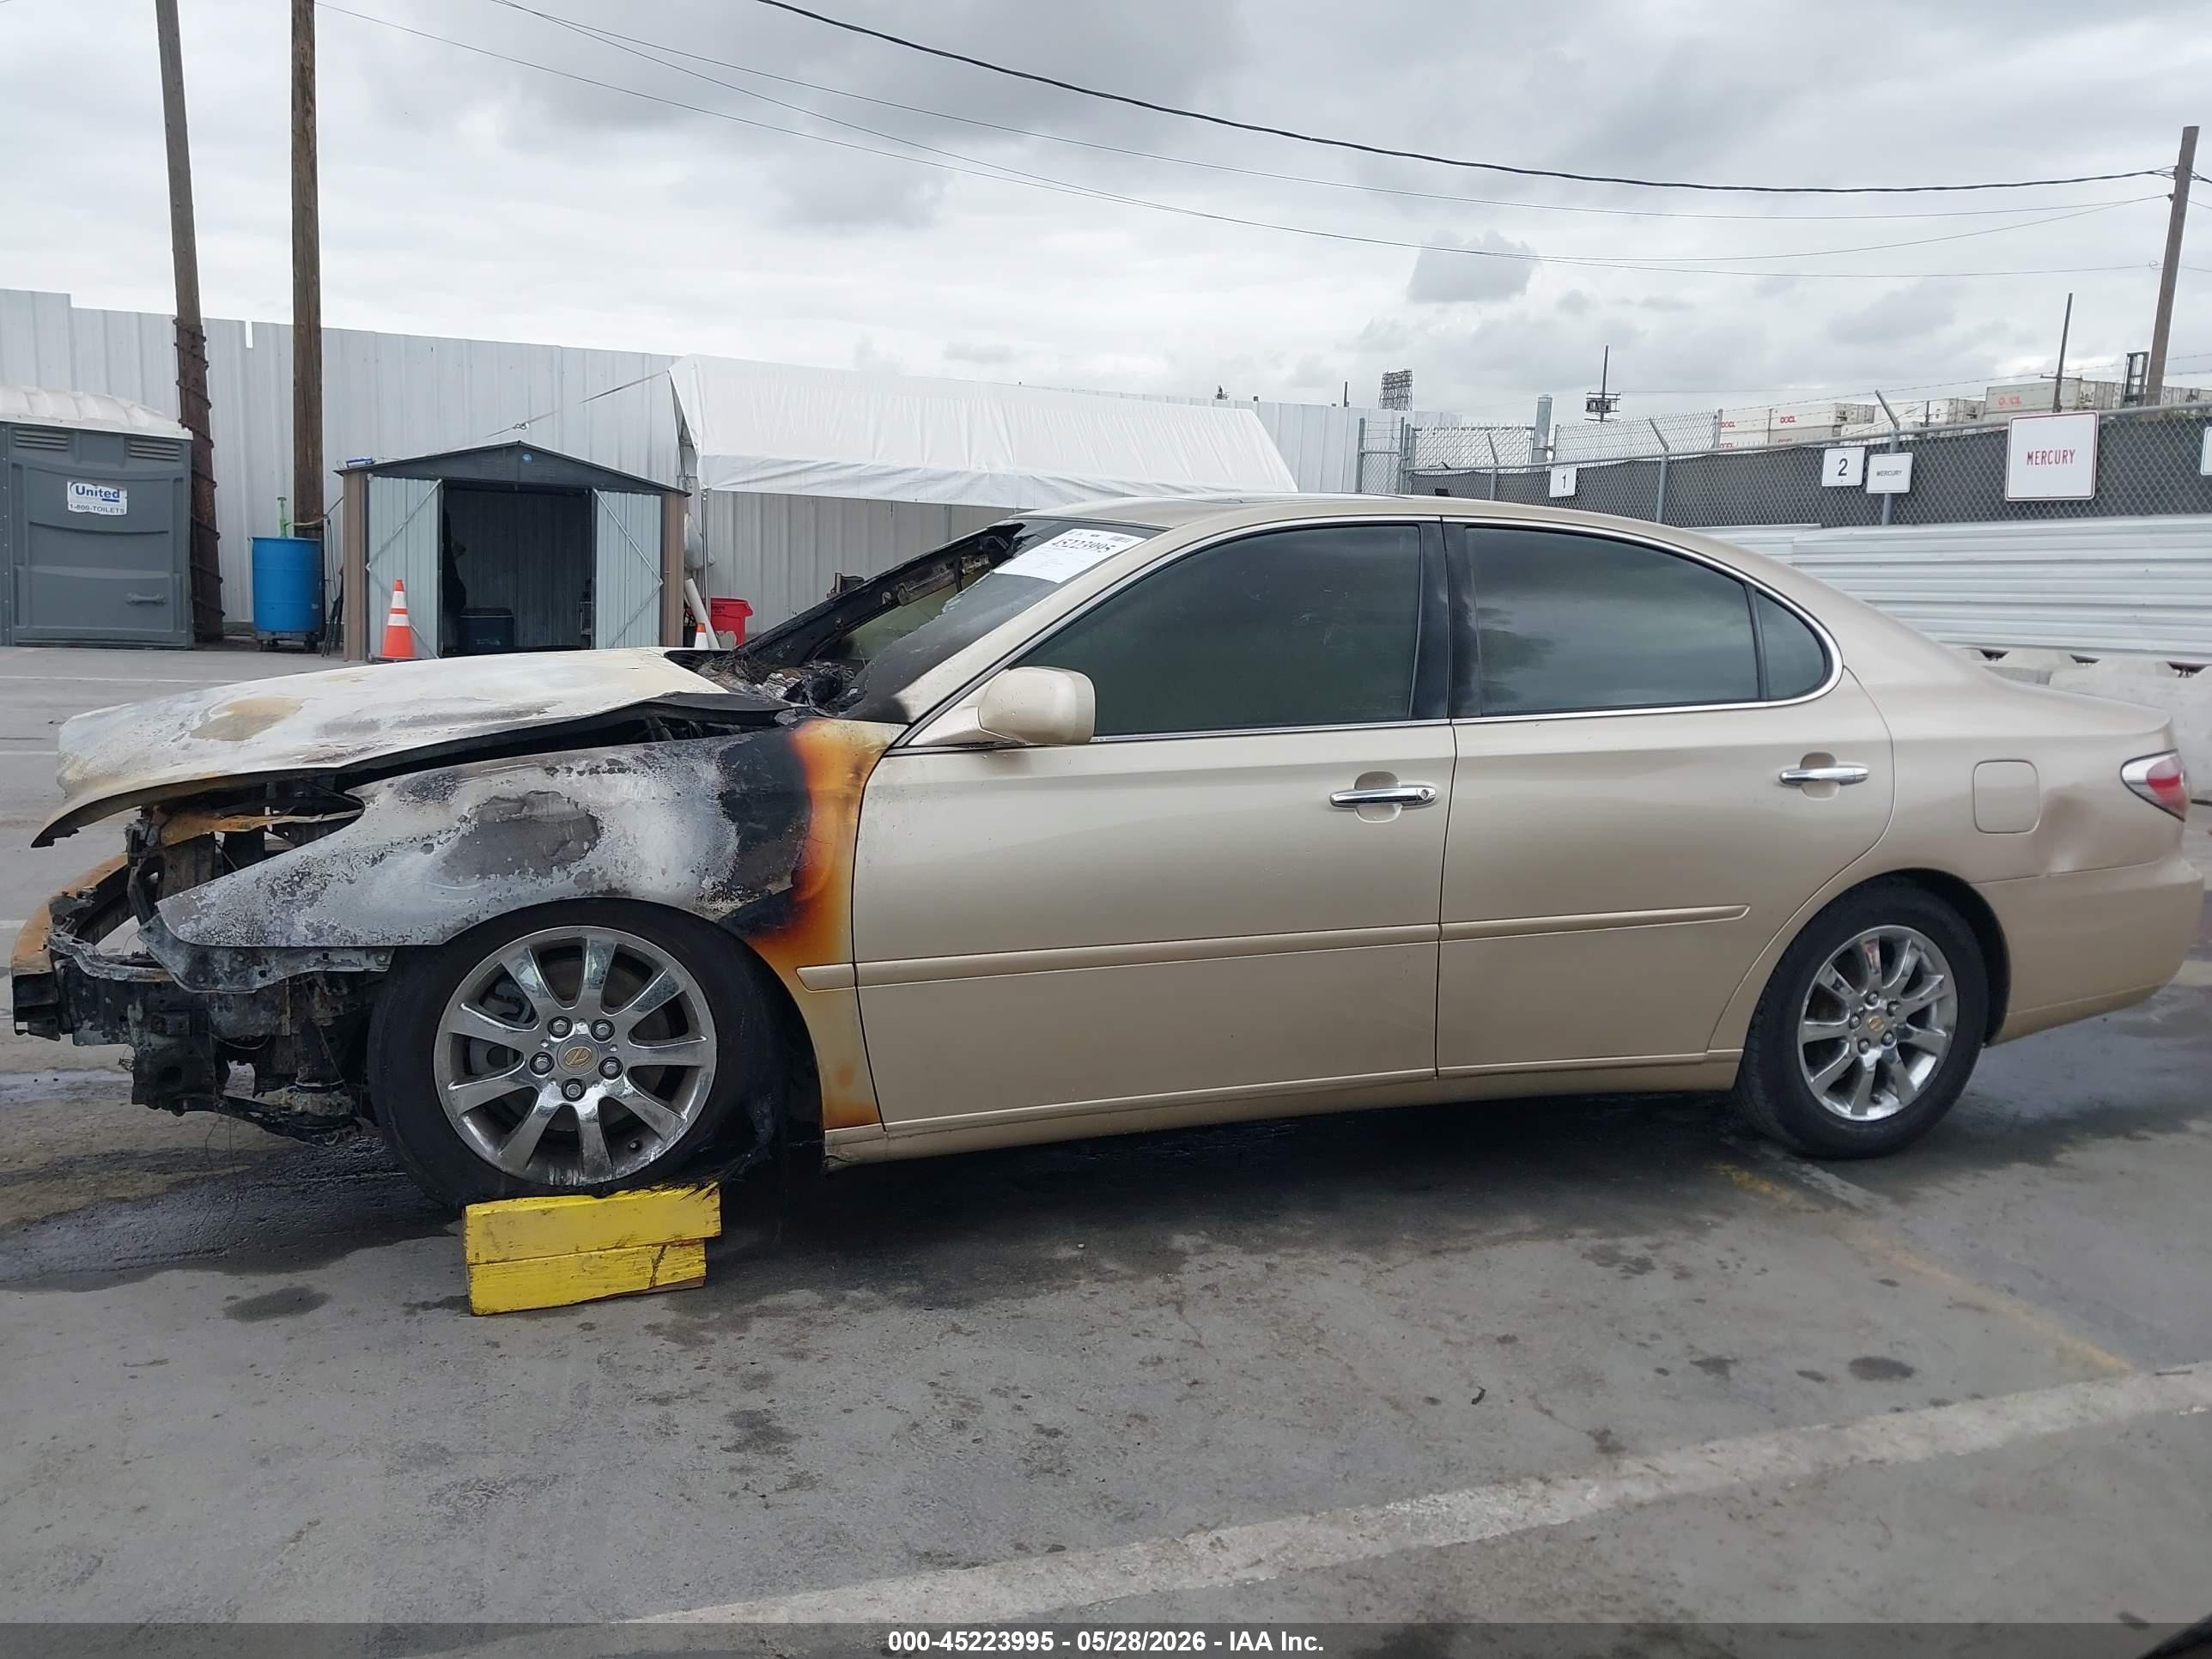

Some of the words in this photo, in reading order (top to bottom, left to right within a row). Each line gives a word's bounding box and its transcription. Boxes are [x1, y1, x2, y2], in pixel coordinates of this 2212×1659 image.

[2027, 448, 2075, 465] MERCURY
[1838, 458, 1849, 477] 2
[1562, 474, 1567, 489] 1
[76, 485, 120, 498] United
[70, 504, 125, 514] 1-800-TOILETS
